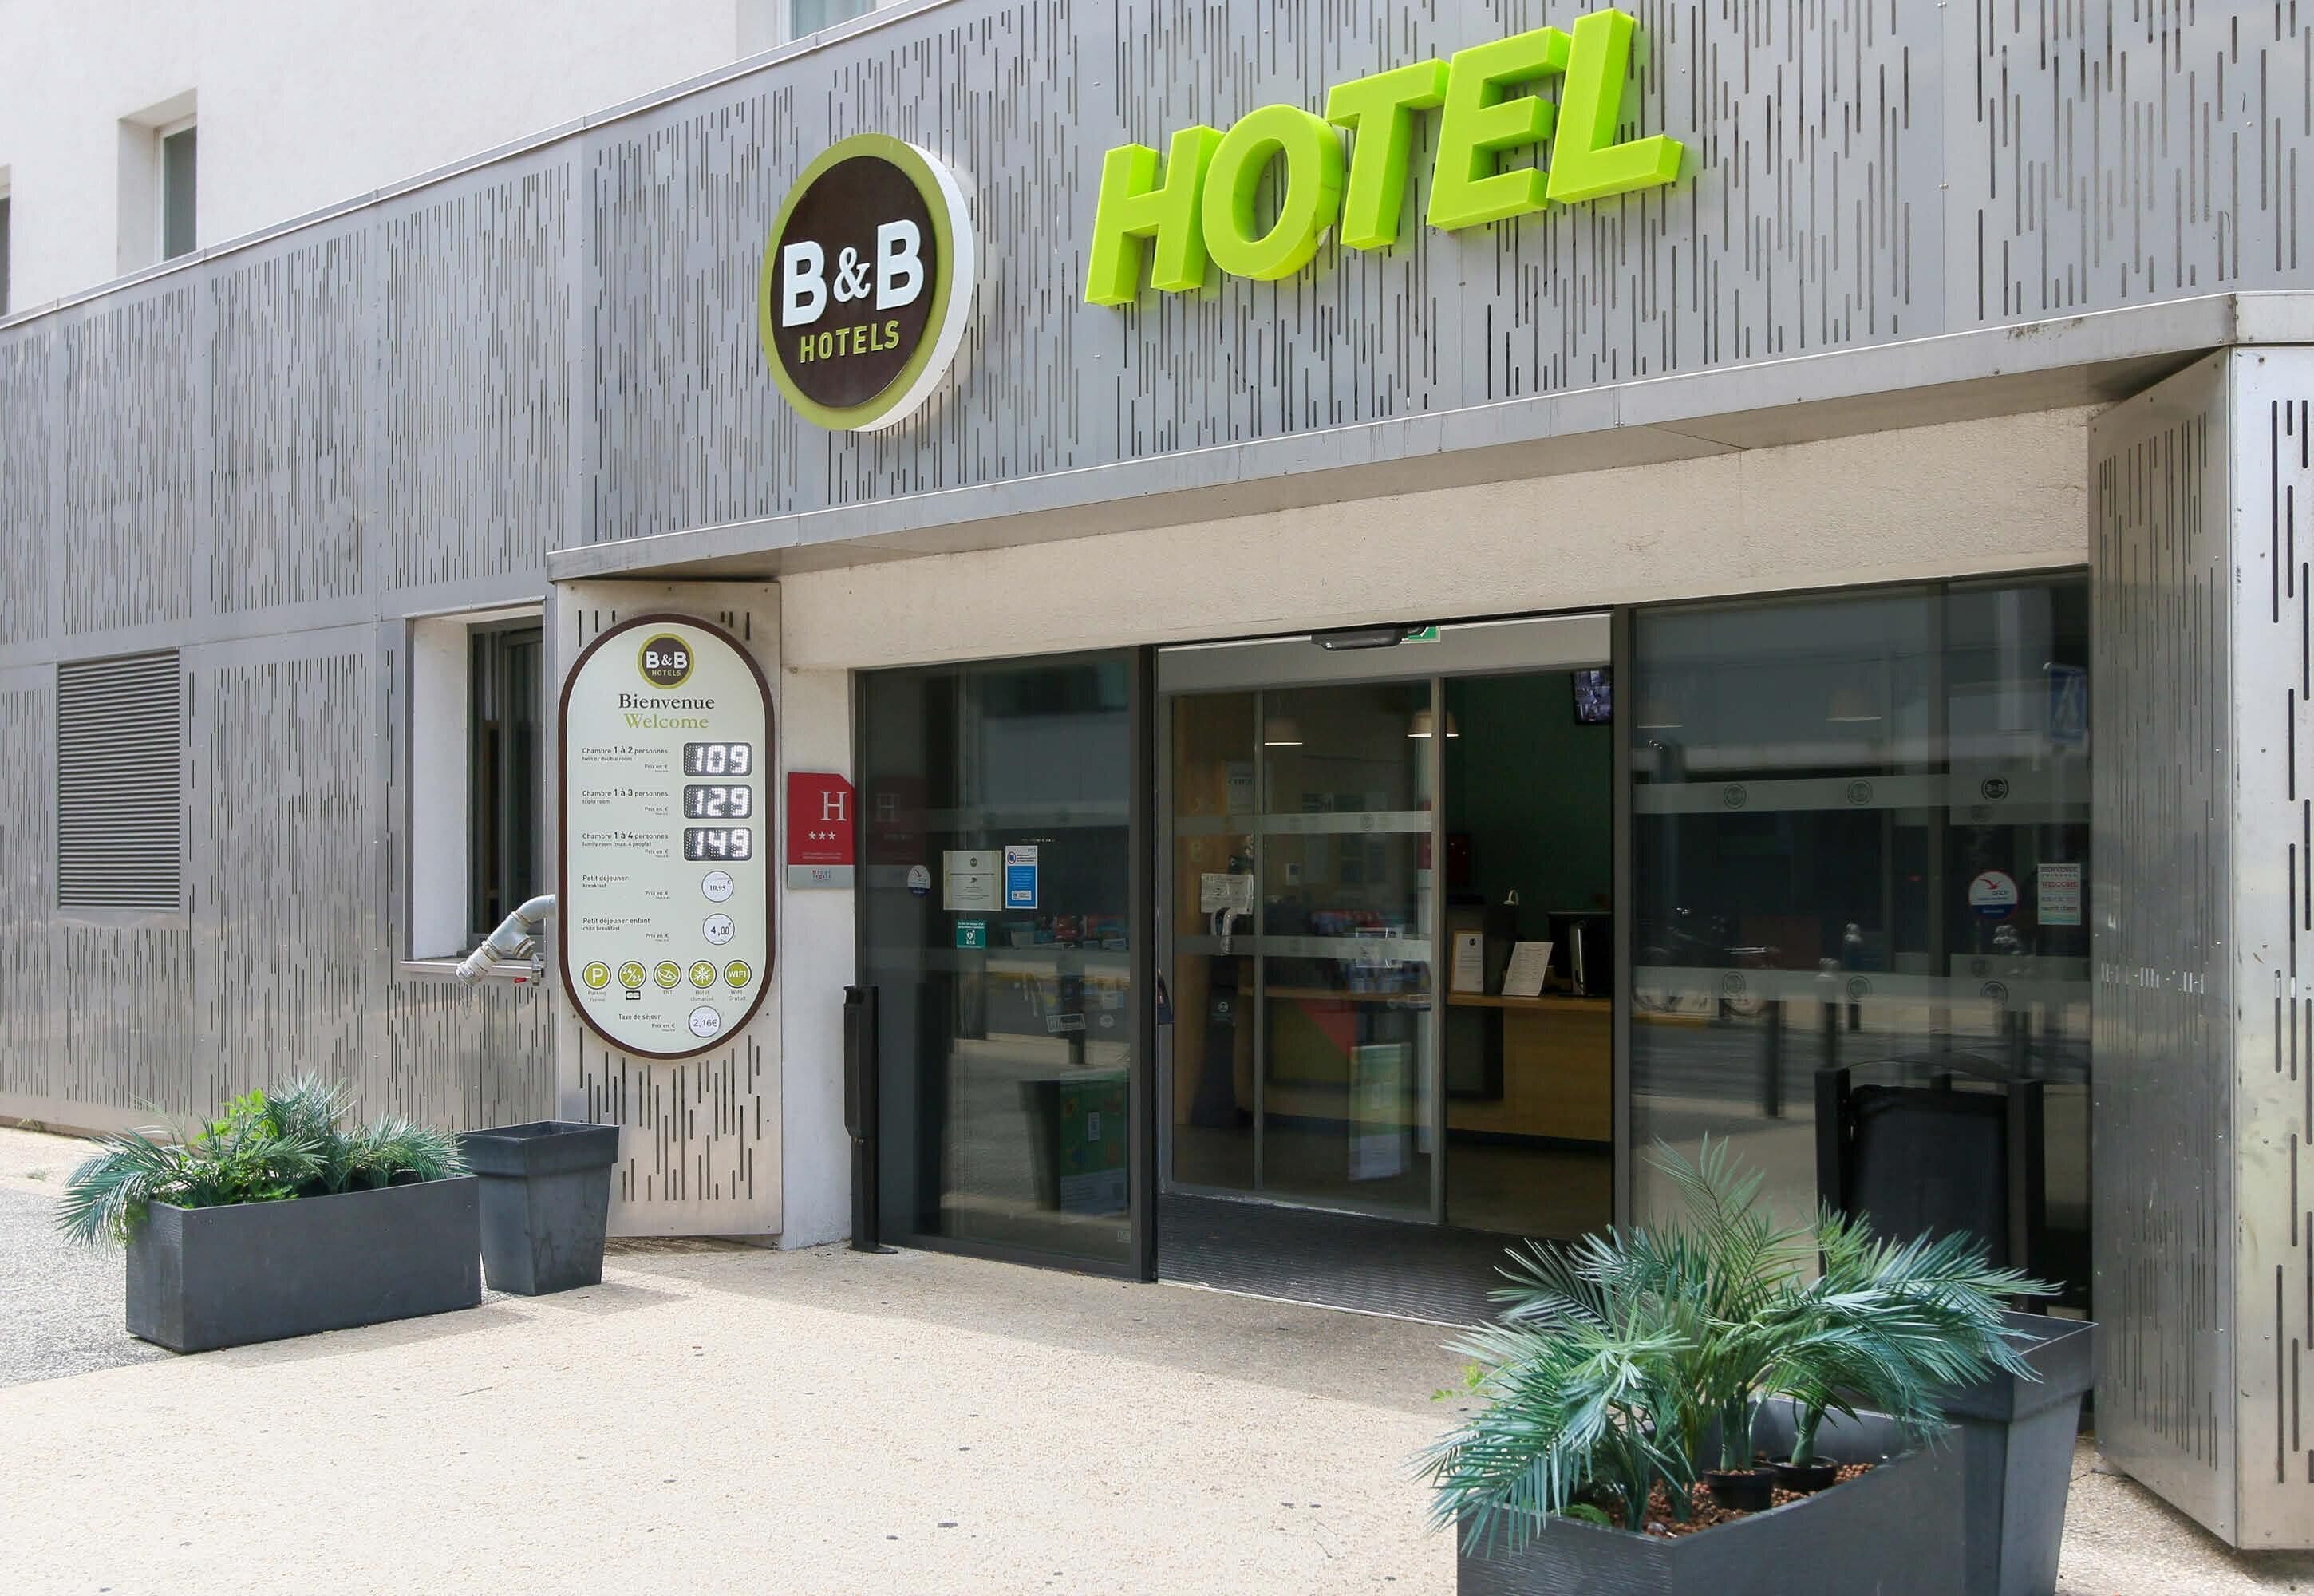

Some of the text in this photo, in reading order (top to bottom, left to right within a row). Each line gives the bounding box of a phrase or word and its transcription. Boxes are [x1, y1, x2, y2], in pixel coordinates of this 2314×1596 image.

[1085, 10, 1684, 306] HOTEL
[781, 218, 924, 328] B&B
[799, 320, 901, 364] HOTELS
[646, 650, 688, 669] B&B
[618, 693, 716, 709] Bienvenue
[624, 713, 709, 729] Welcome
[620, 745, 626, 754] à
[696, 745, 749, 773] 109
[620, 788, 626, 797] à
[696, 788, 749, 816] 129
[820, 791, 847, 821] H
[620, 830, 626, 839] à
[696, 828, 749, 857] 149
[592, 968, 603, 983] P
